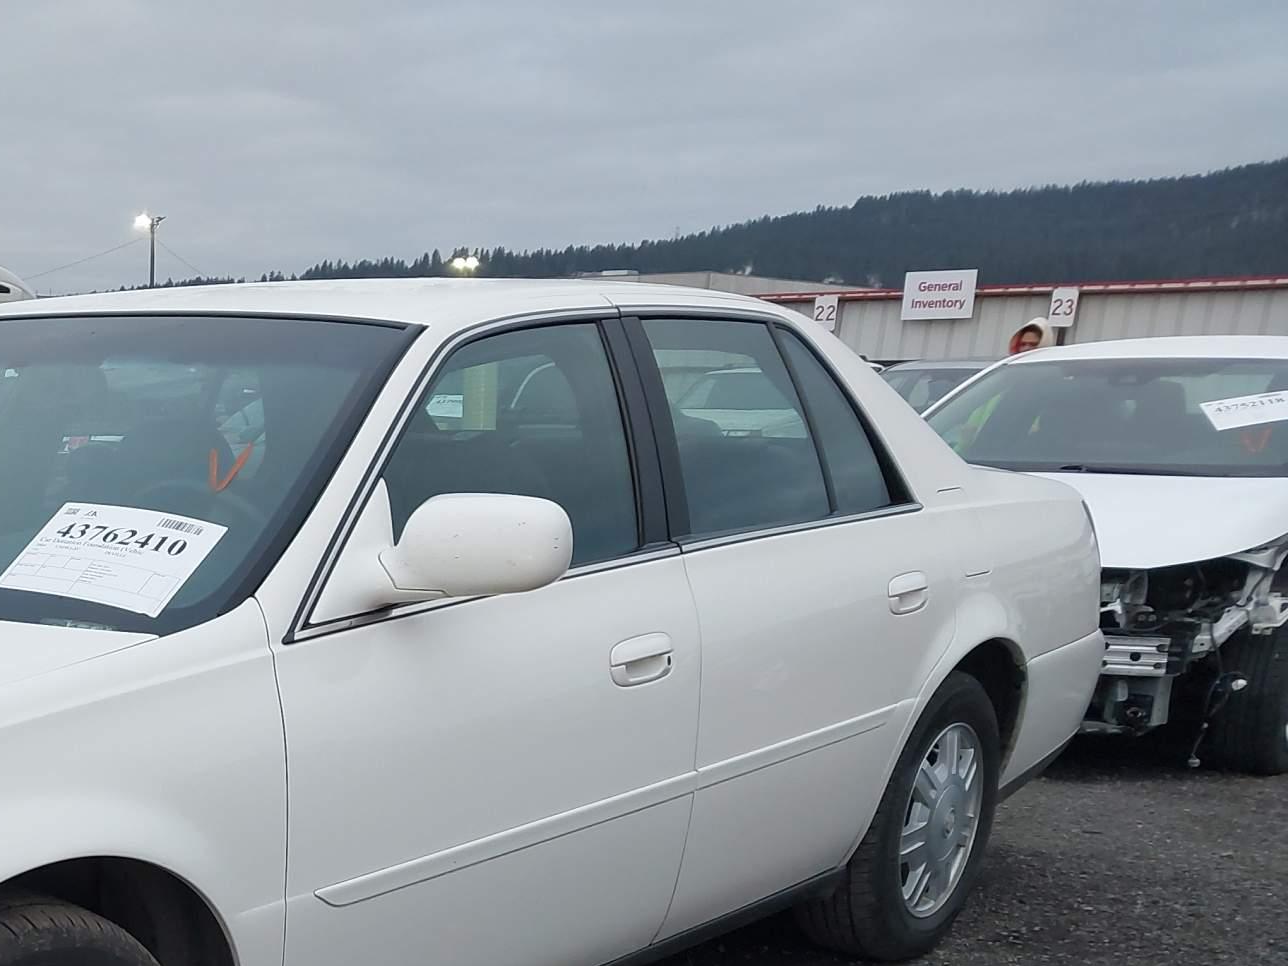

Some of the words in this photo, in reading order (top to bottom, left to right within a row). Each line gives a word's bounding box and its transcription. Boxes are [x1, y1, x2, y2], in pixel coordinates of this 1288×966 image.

[918, 280, 963, 292] General
[814, 304, 836, 321] 22
[911, 298, 966, 310] Inventory
[1052, 298, 1074, 316] 23
[56, 522, 188, 556] 43762410
